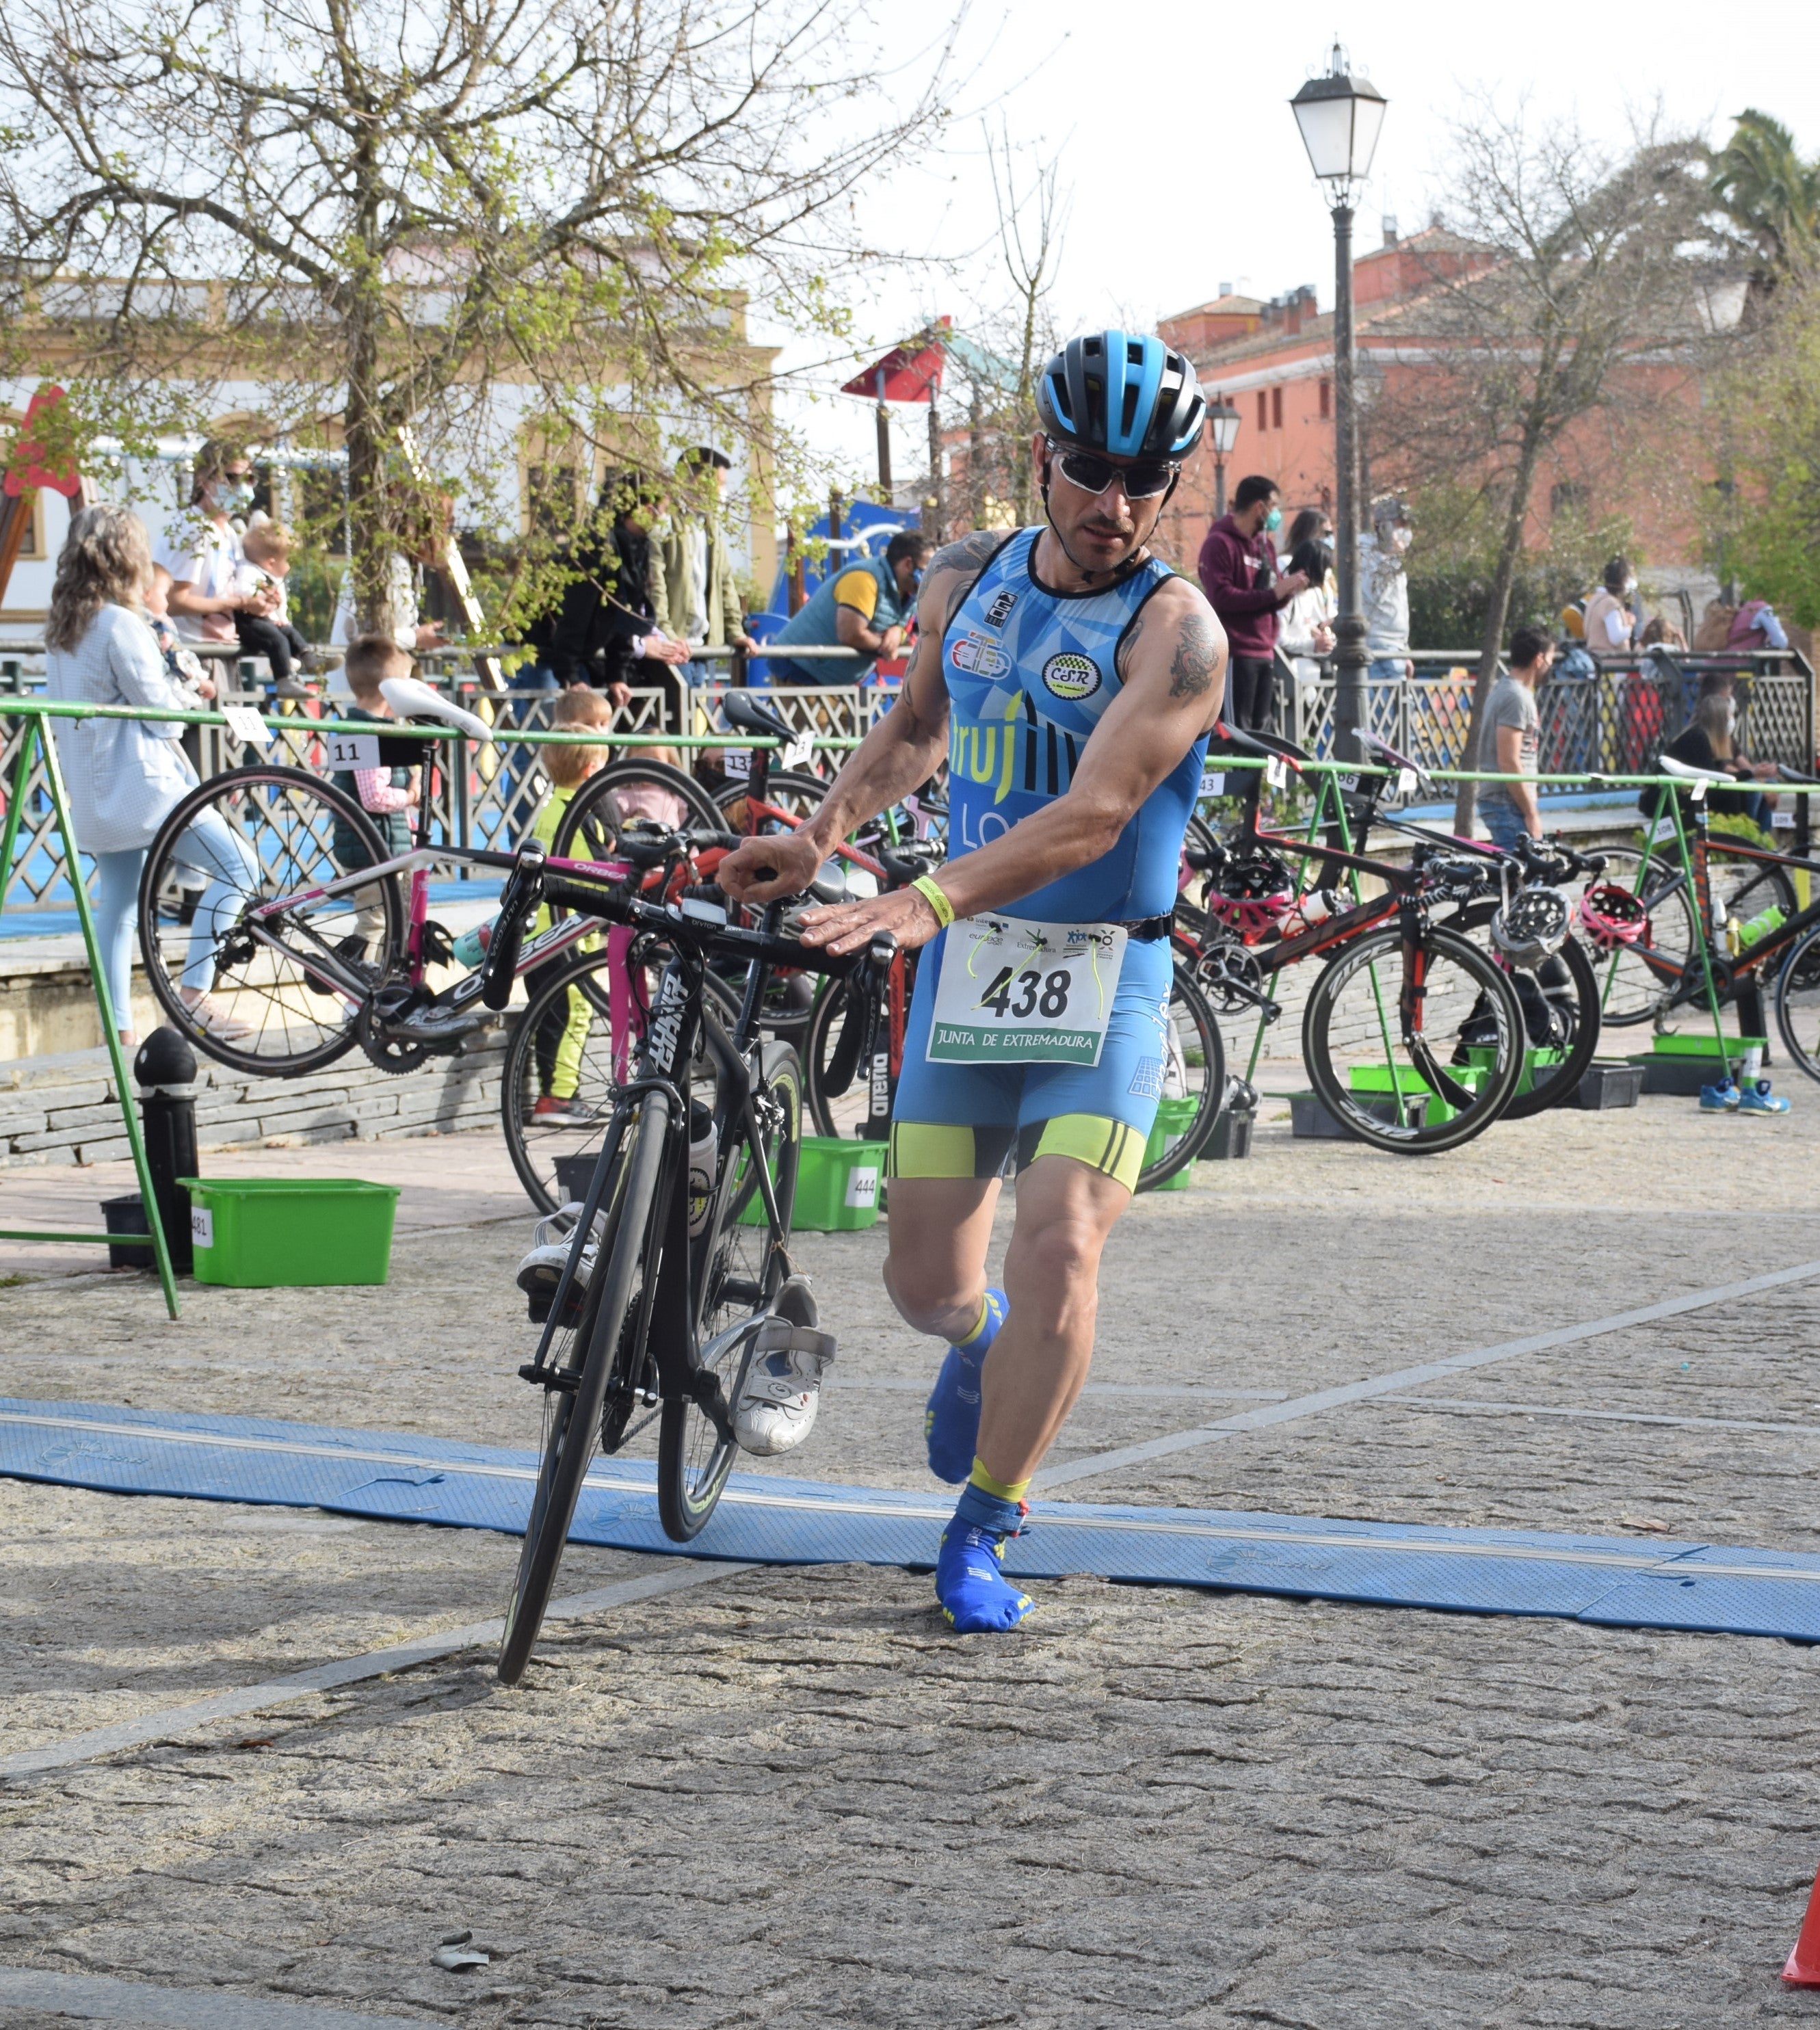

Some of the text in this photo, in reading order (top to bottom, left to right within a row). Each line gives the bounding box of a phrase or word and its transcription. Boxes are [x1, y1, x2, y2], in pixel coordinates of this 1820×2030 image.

[239, 717, 257, 730] 11
[334, 743, 360, 761] 11
[573, 862, 628, 880] ORBEA
[490, 900, 518, 957] ULTEGRA
[1017, 941, 1057, 953] Extremdura
[981, 966, 1072, 1018] 438
[865, 996, 876, 1057] ULTEGRA
[937, 1029, 1093, 1049] JUNTA DE EXTREMADURA
[871, 1053, 889, 1117] arena
[855, 1179, 875, 1195] 444
